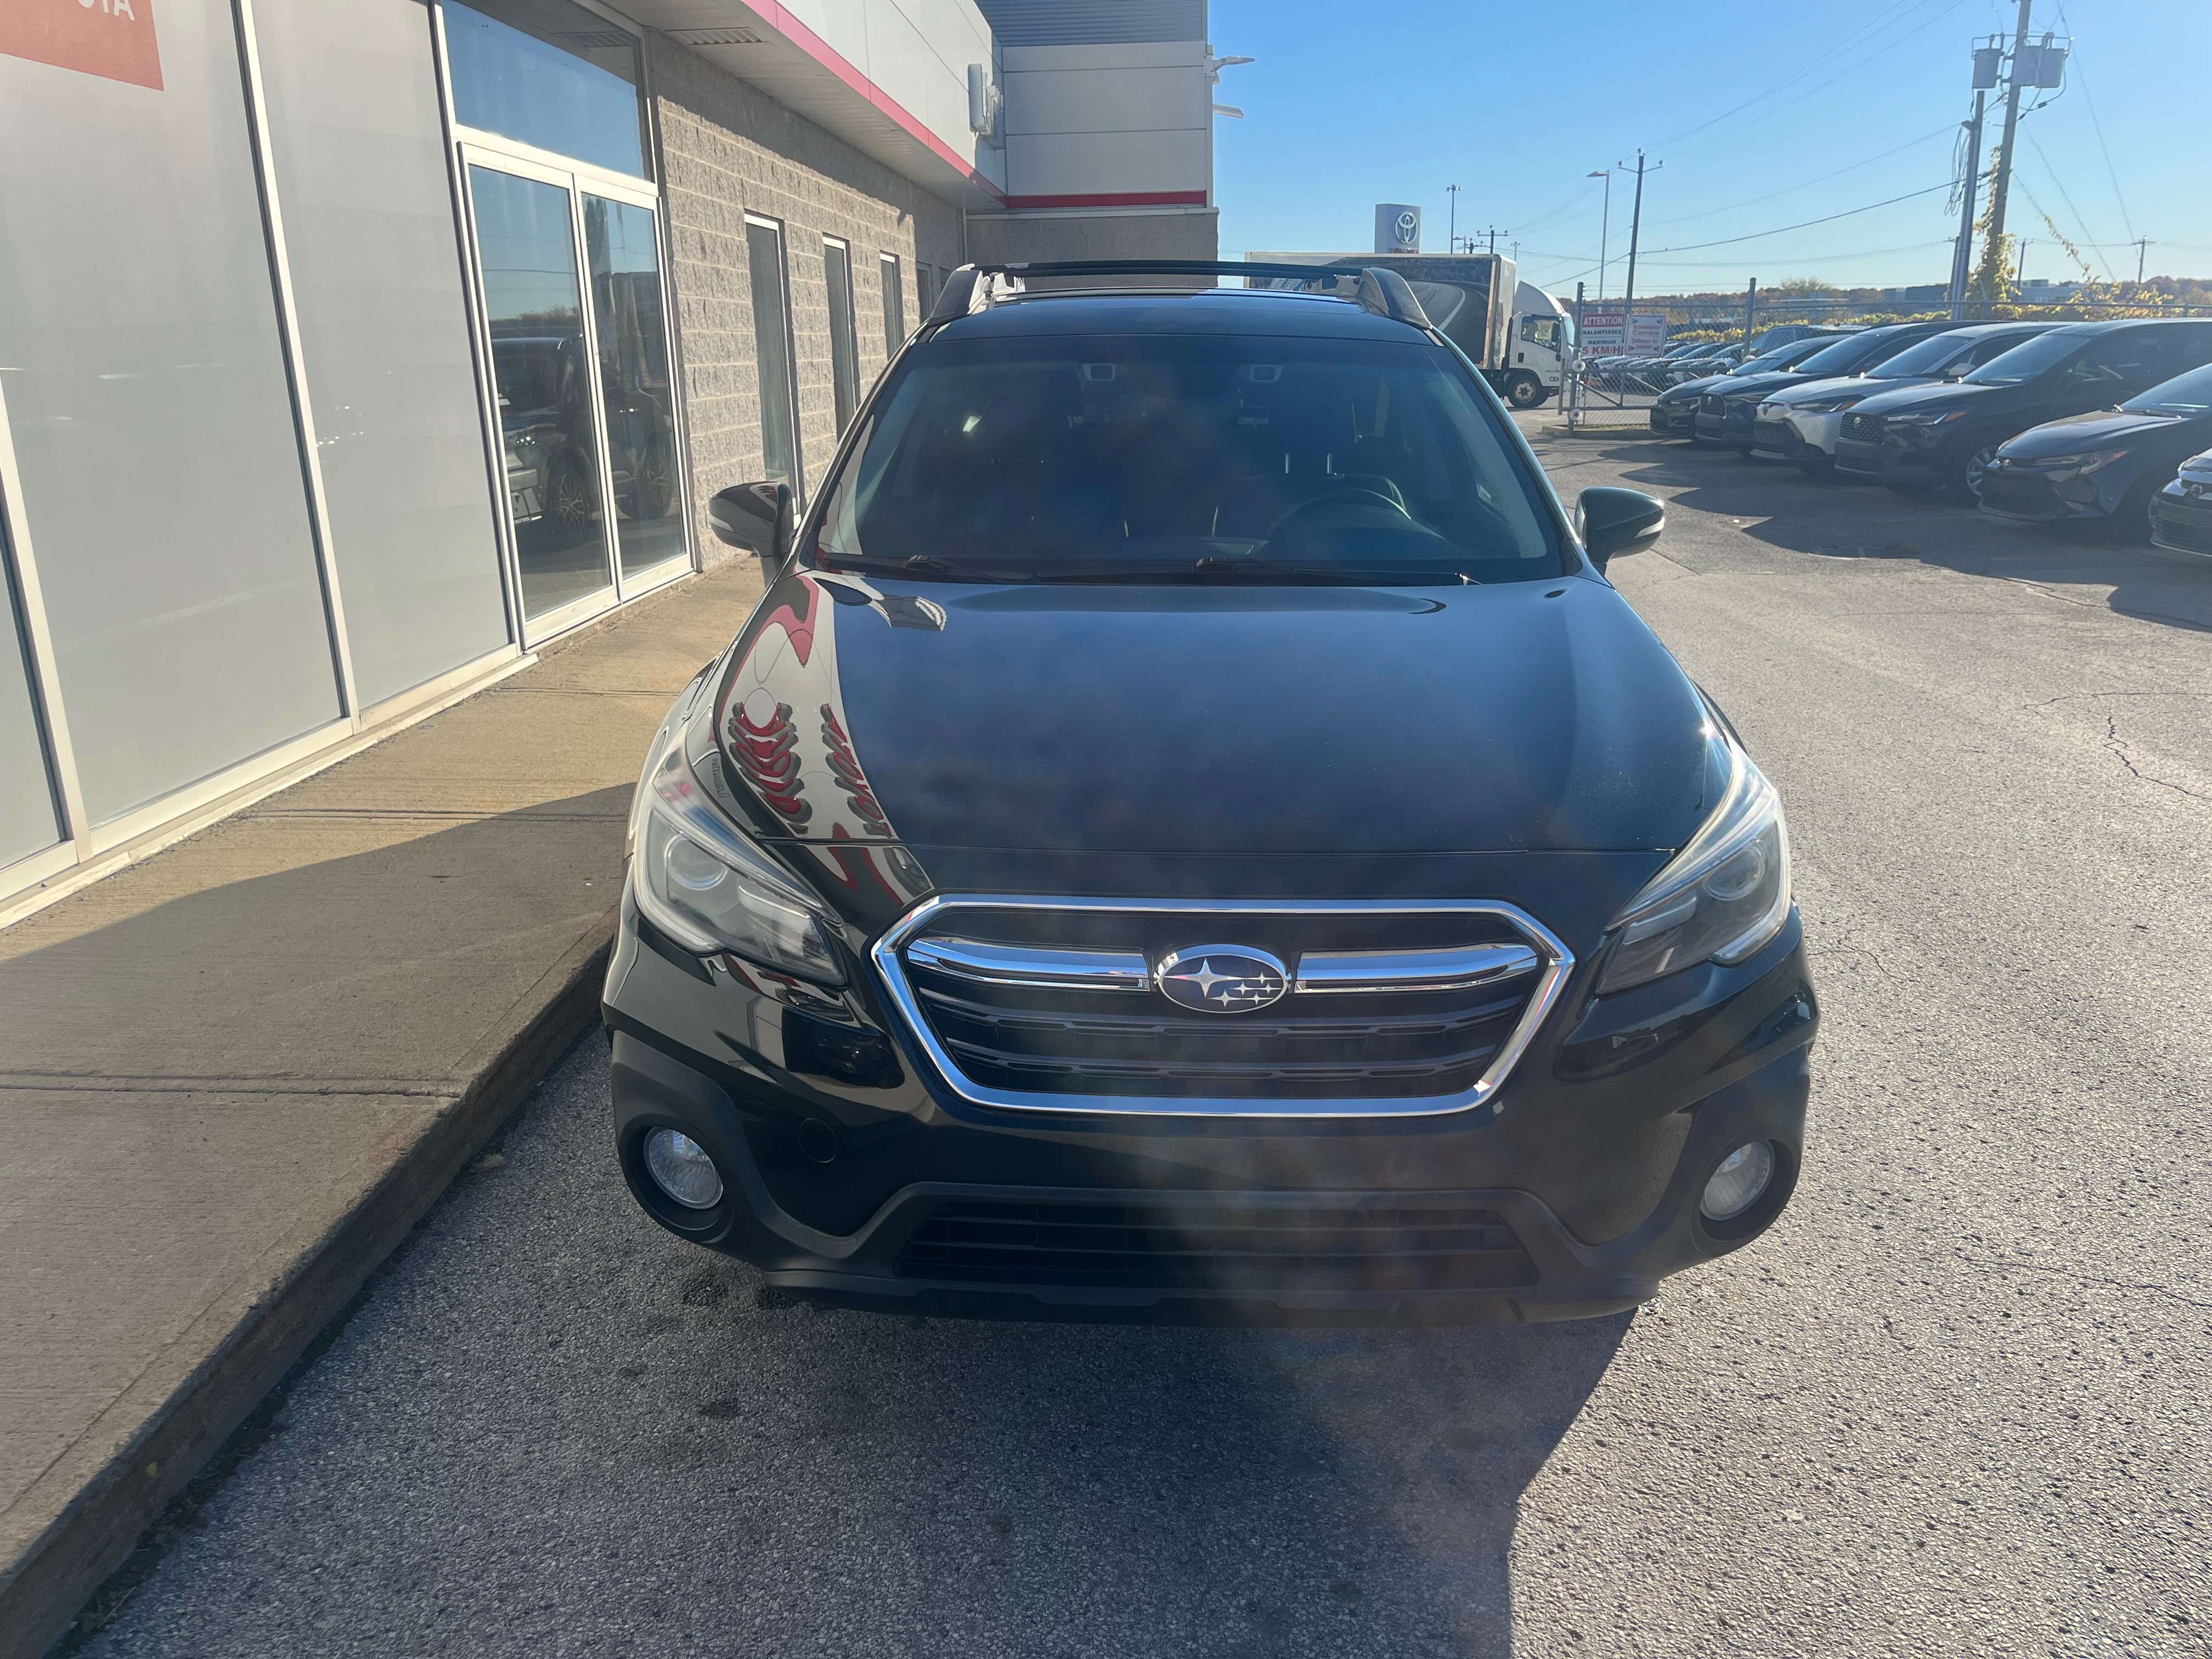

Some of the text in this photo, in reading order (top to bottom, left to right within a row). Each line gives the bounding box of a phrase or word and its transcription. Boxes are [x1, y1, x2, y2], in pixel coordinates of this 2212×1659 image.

[1583, 315, 1623, 325] ATTENTION
[1582, 346, 1621, 355] 5 KM/H
